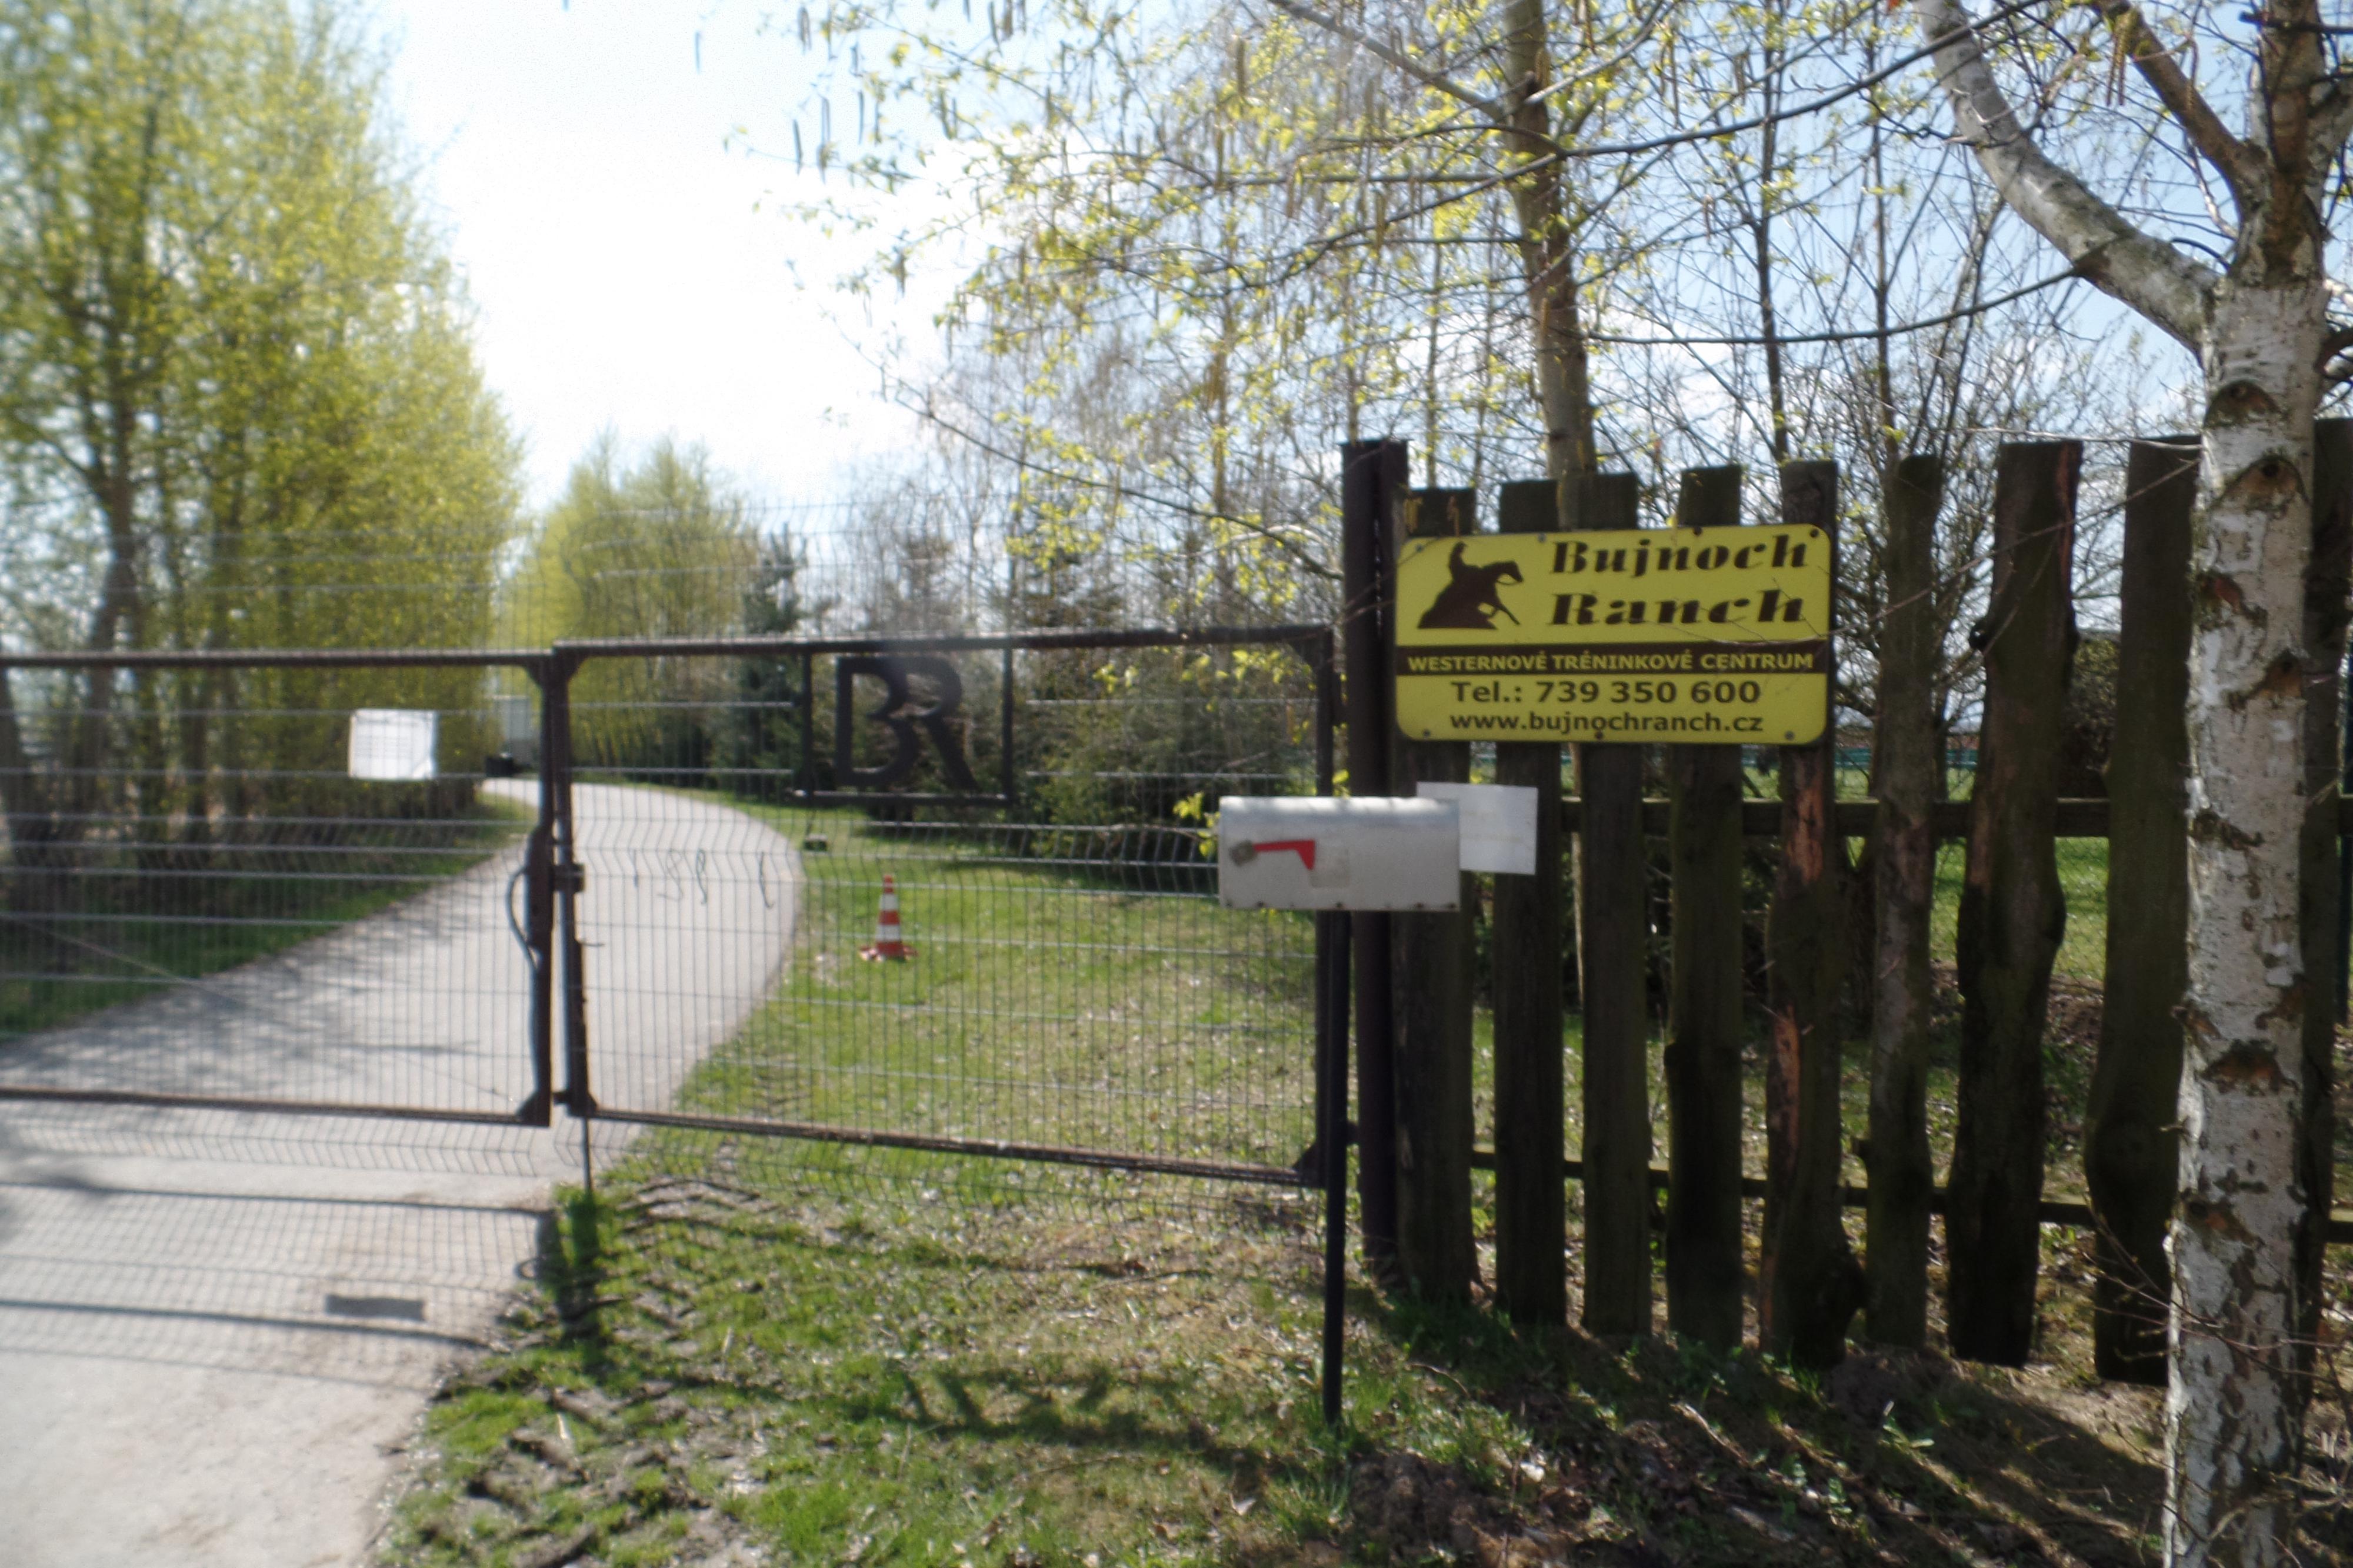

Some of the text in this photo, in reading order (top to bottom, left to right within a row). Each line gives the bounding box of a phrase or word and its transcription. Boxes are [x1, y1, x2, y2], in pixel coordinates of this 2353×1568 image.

[1550, 534, 1808, 579] Bujnoch
[1549, 589, 1805, 626] Ranch
[1408, 649, 1814, 672] WESTERNOVÉ TRÉNINKOVÉ CENTRUM
[1451, 680, 1761, 703] Tel.: 739 350 600
[1450, 710, 1764, 734] www.bujnochranch.cz
